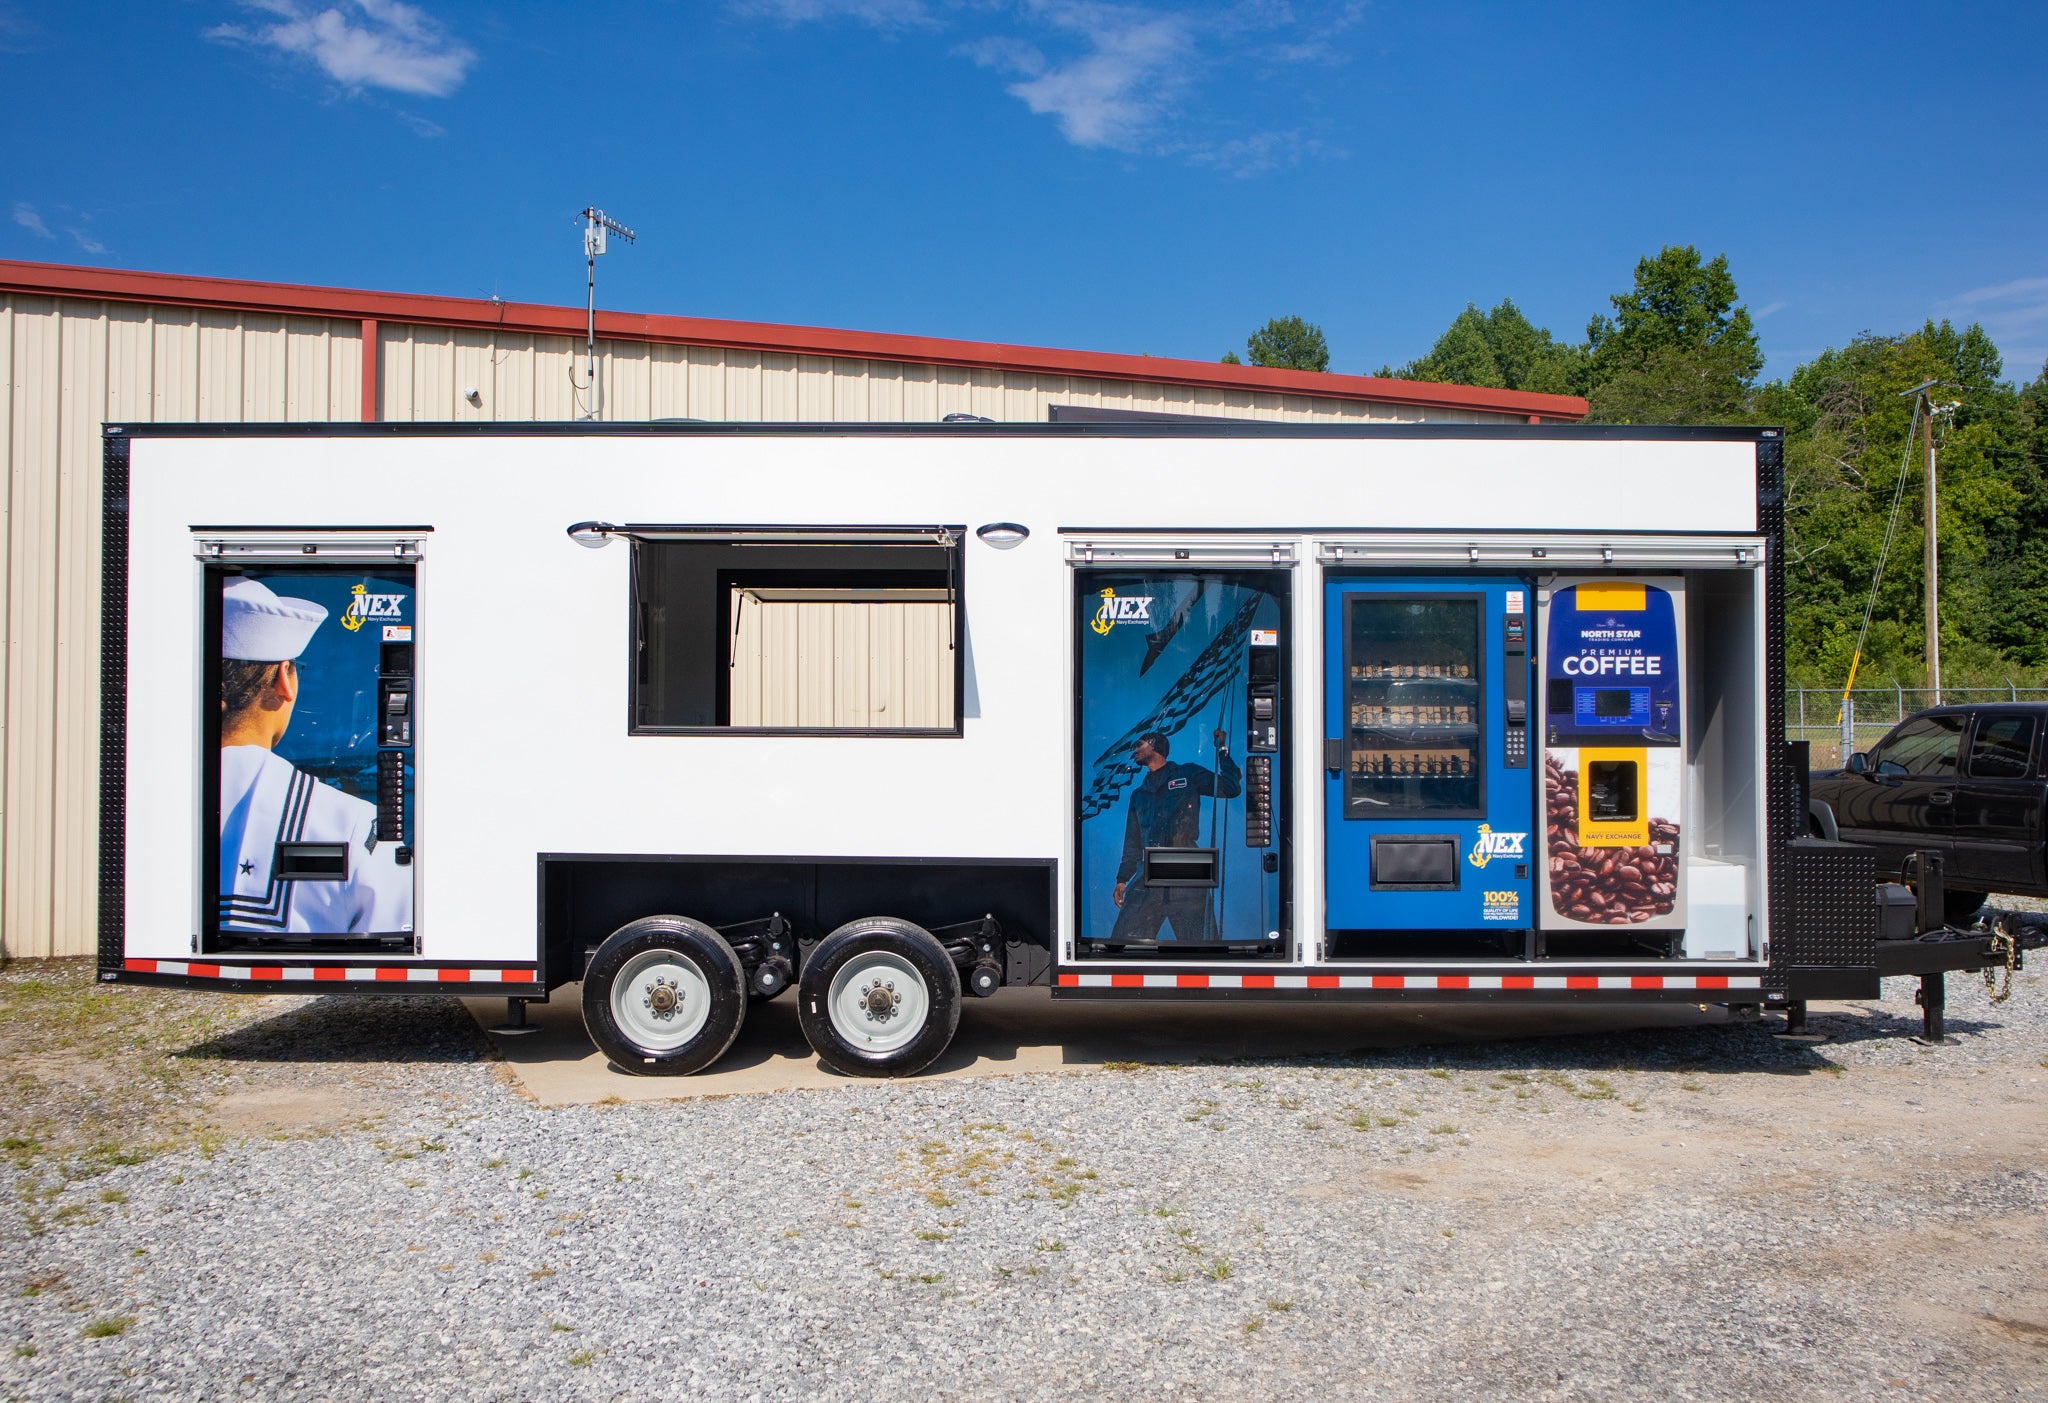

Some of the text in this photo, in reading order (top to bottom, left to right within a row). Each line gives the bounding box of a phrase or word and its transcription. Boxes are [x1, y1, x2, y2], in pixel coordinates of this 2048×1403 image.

[351, 594, 406, 616] NEX
[1101, 597, 1153, 619] NEX
[1581, 630, 1641, 638] NORTH STAR
[1581, 648, 1642, 656] PREMIUM
[1562, 656, 1661, 675] COFFEE
[1477, 832, 1527, 854] NEX
[1483, 891, 1519, 902] 100%
